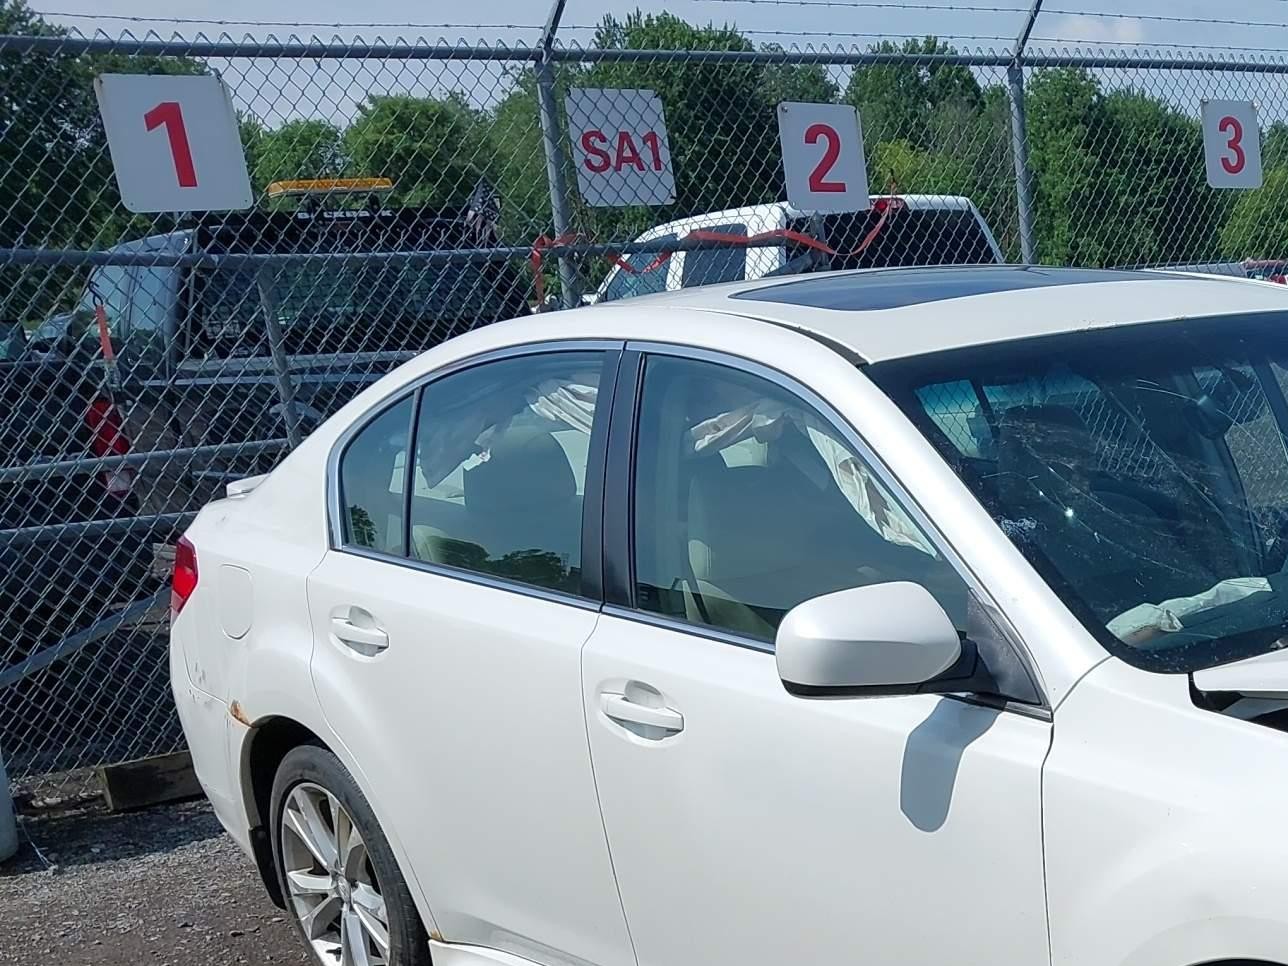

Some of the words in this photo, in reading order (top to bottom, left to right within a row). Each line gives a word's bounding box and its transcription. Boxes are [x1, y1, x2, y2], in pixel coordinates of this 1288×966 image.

[145, 103, 197, 187] 1
[582, 131, 662, 173] SA1
[805, 125, 846, 192] 2
[1218, 117, 1246, 175] 3
